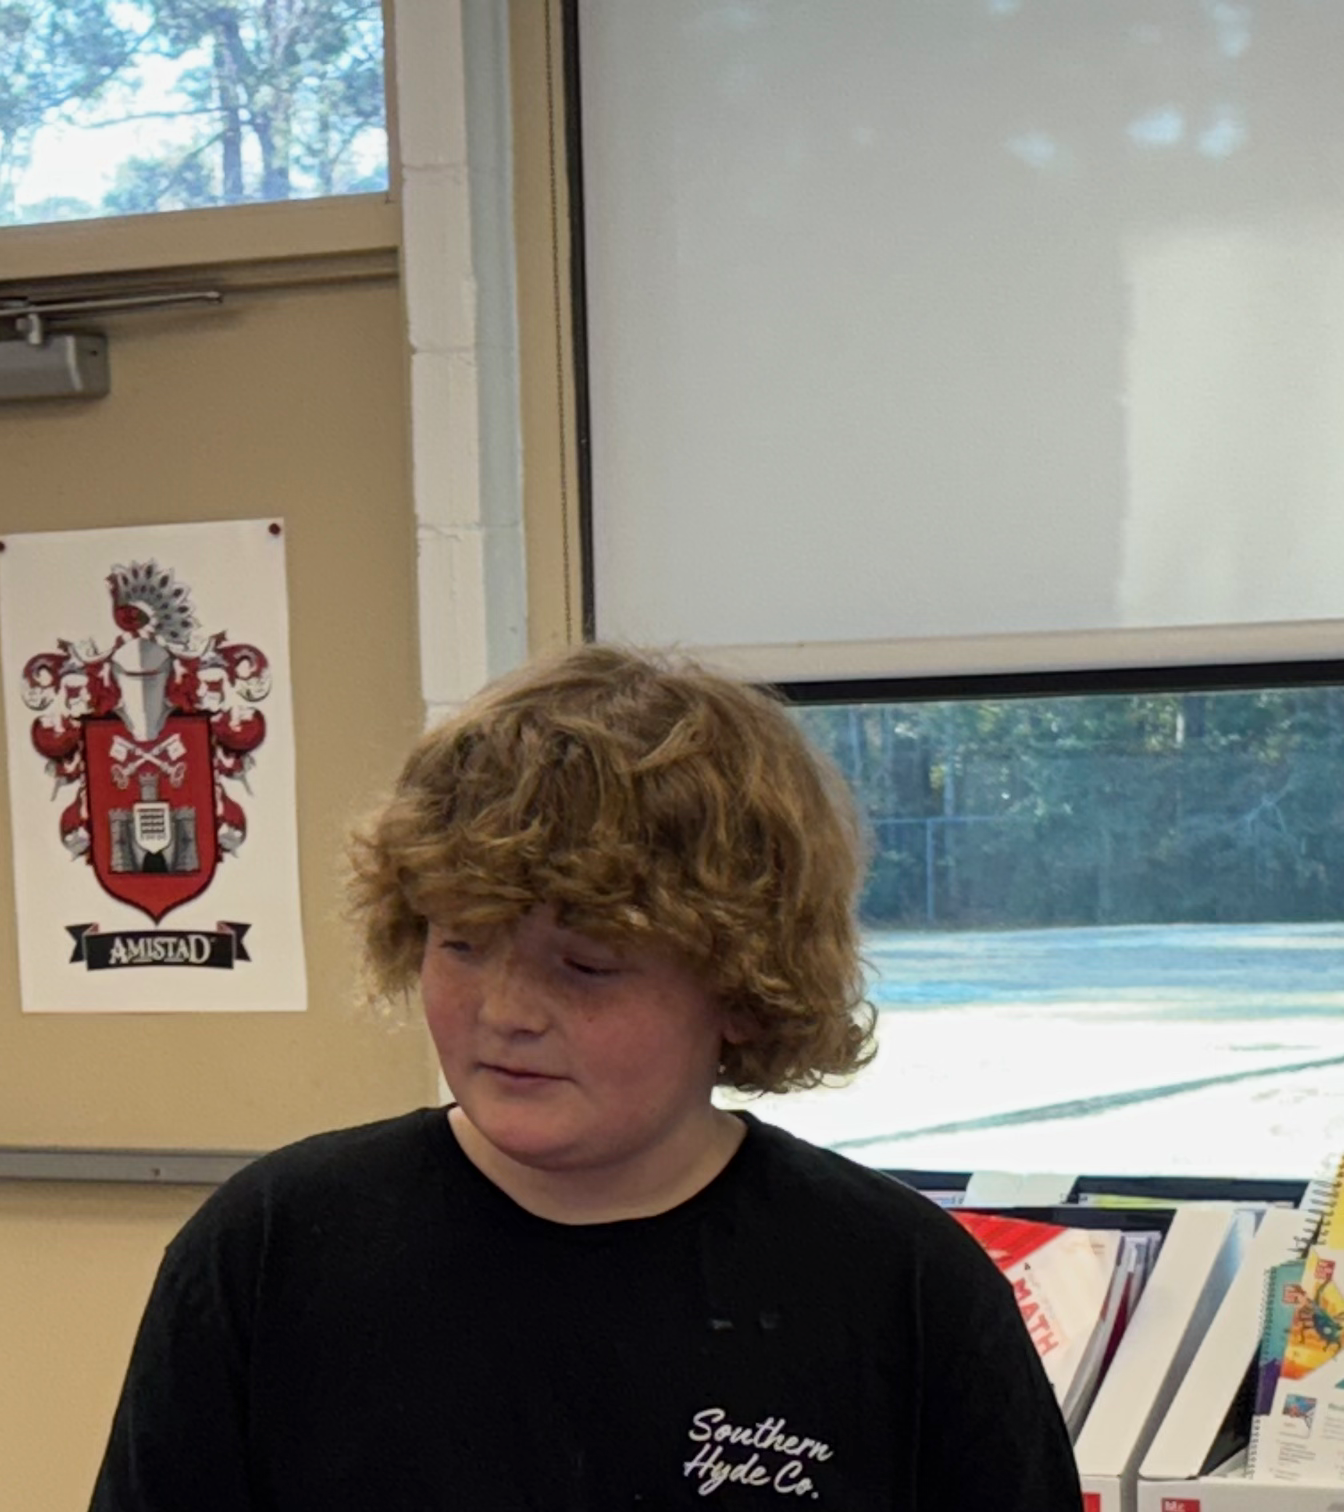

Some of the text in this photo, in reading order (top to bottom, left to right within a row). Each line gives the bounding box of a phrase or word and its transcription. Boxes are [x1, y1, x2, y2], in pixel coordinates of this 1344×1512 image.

[109, 934, 211, 965] AMISTAD
[1013, 1277, 1059, 1357] MATH
[688, 1408, 834, 1461] Southern
[683, 1442, 819, 1499] Hyde Co.
